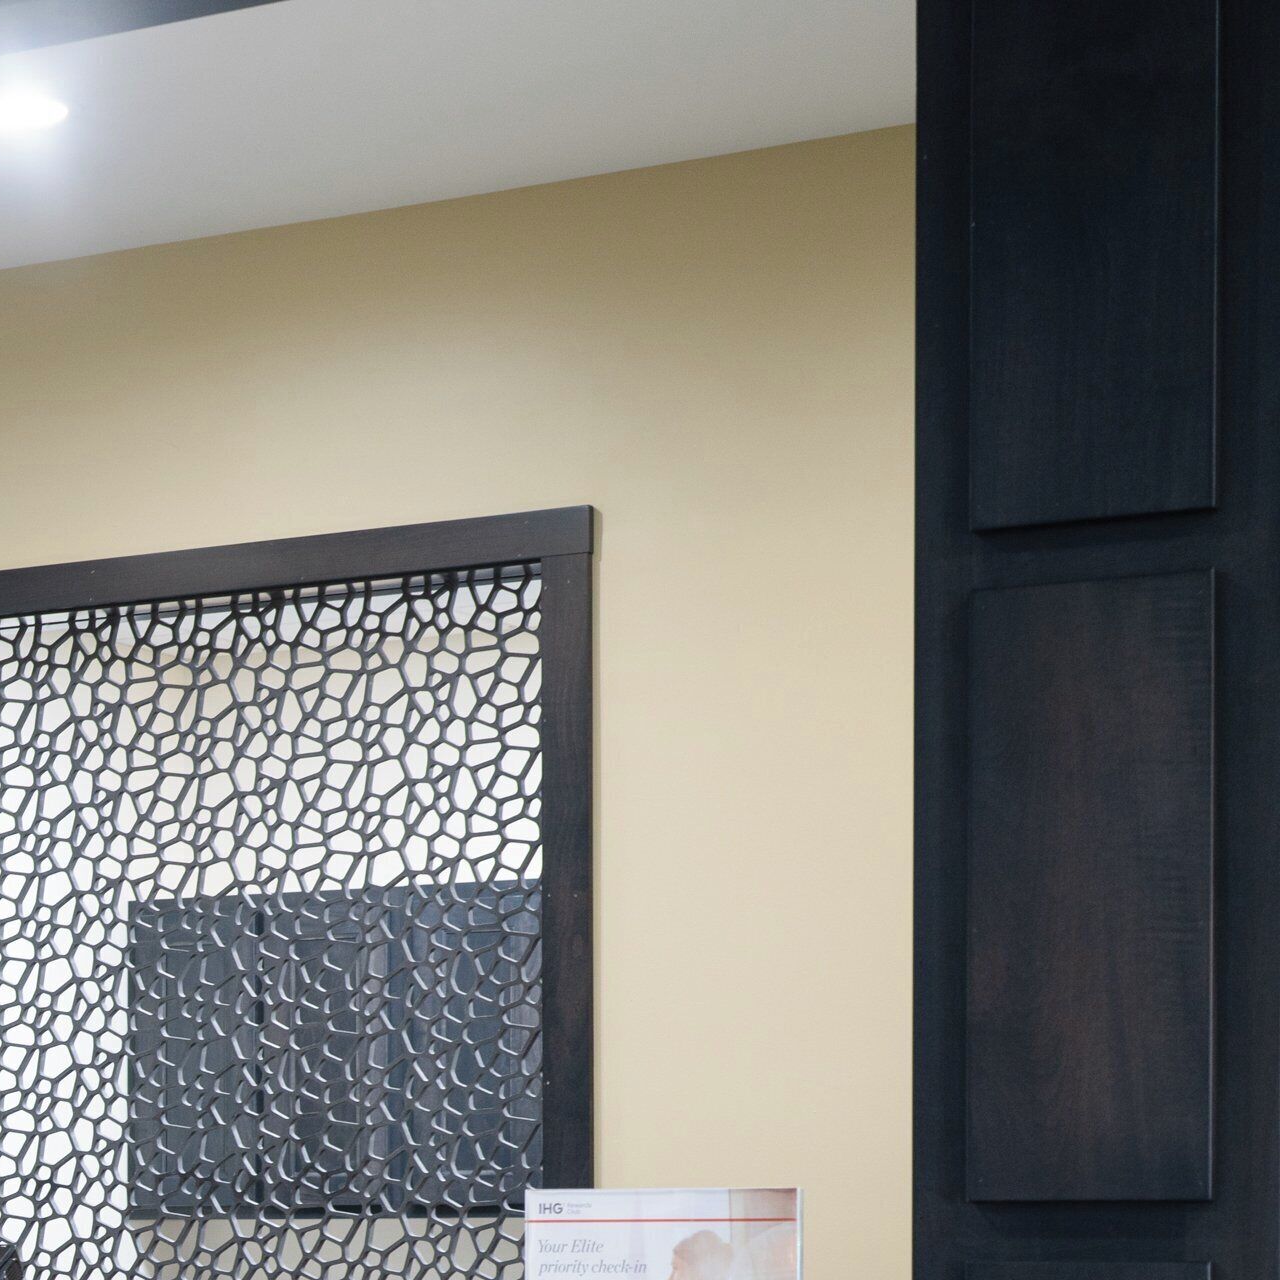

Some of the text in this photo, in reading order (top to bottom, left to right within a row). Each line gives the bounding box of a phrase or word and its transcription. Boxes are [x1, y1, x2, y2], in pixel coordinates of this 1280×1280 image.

[538, 1203, 563, 1214] IHG
[538, 1239, 604, 1254] Your Elite
[538, 1259, 647, 1277] priority check-in
